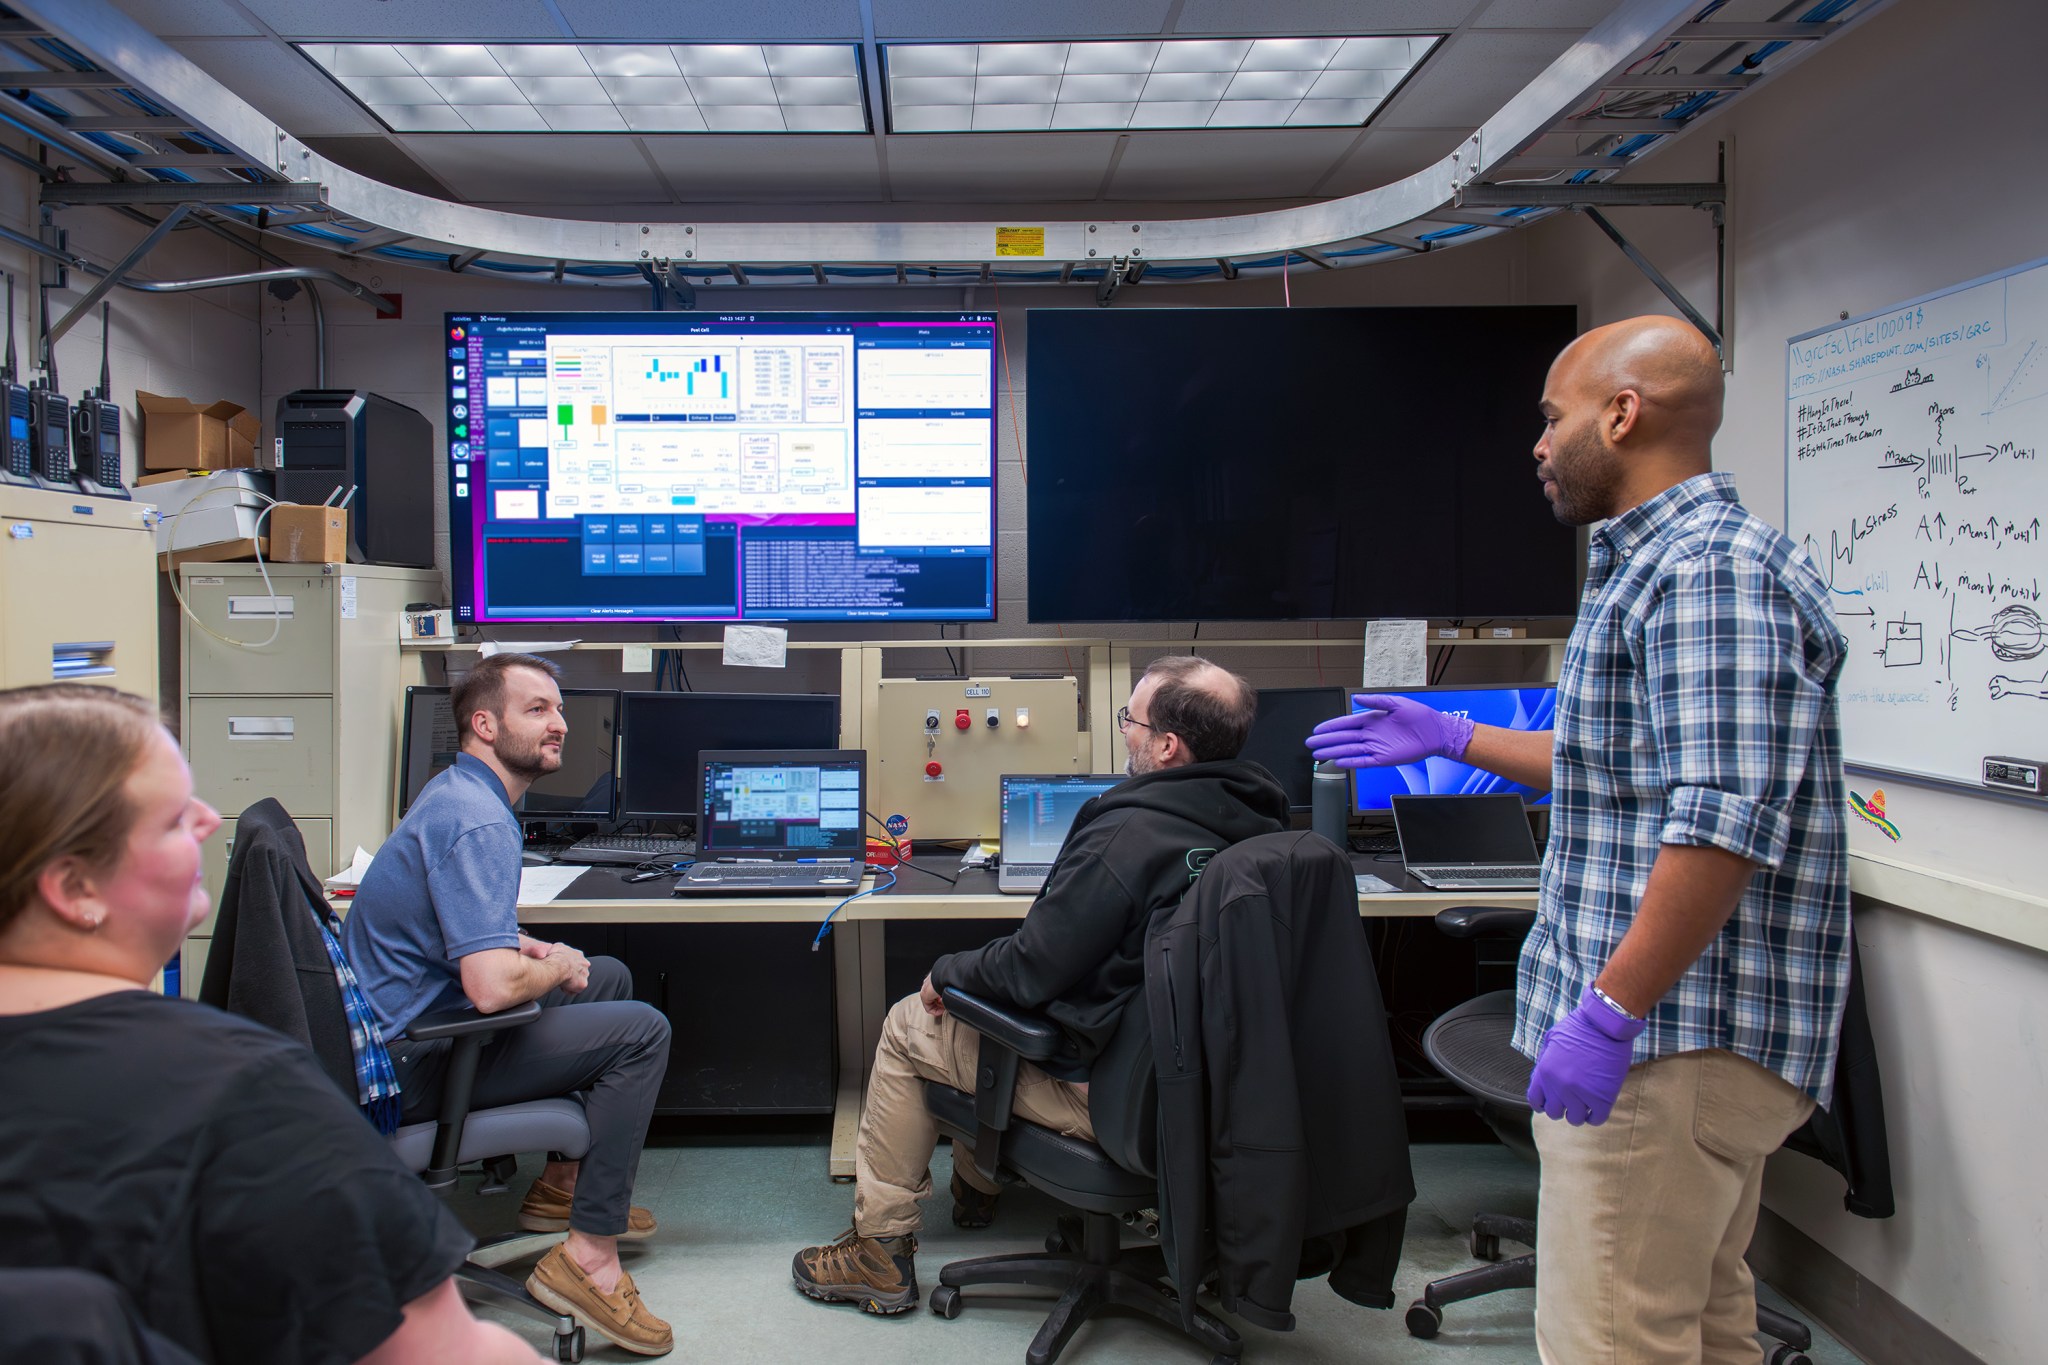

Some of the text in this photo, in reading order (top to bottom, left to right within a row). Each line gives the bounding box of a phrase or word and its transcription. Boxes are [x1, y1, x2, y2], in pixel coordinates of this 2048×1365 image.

[1865, 503, 1898, 535] Stress
[1914, 561, 1930, 589] A
[888, 822, 907, 830] NASA
